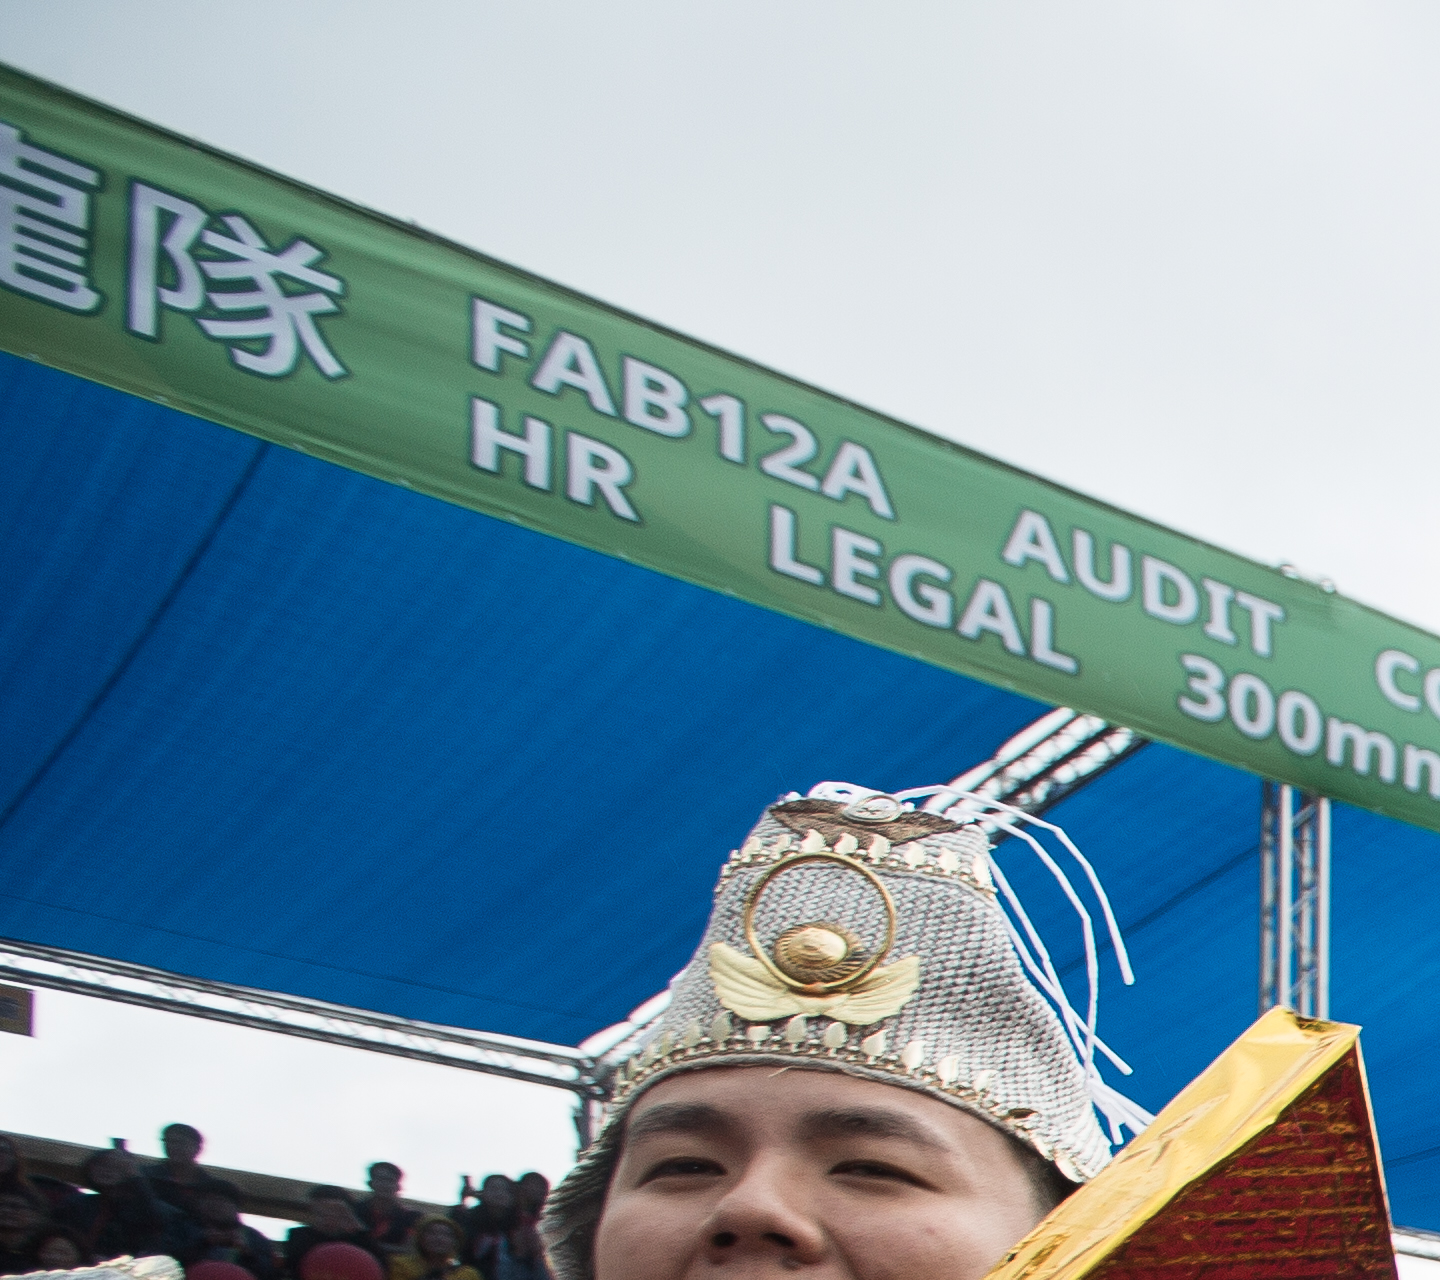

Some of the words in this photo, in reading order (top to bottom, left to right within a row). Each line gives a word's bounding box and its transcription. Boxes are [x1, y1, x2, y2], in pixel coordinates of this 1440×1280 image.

[468, 298, 896, 518] FAB12A
[1003, 510, 1284, 657] AUDIT
[469, 400, 642, 523] HR
[767, 504, 1078, 674] LEGAL
